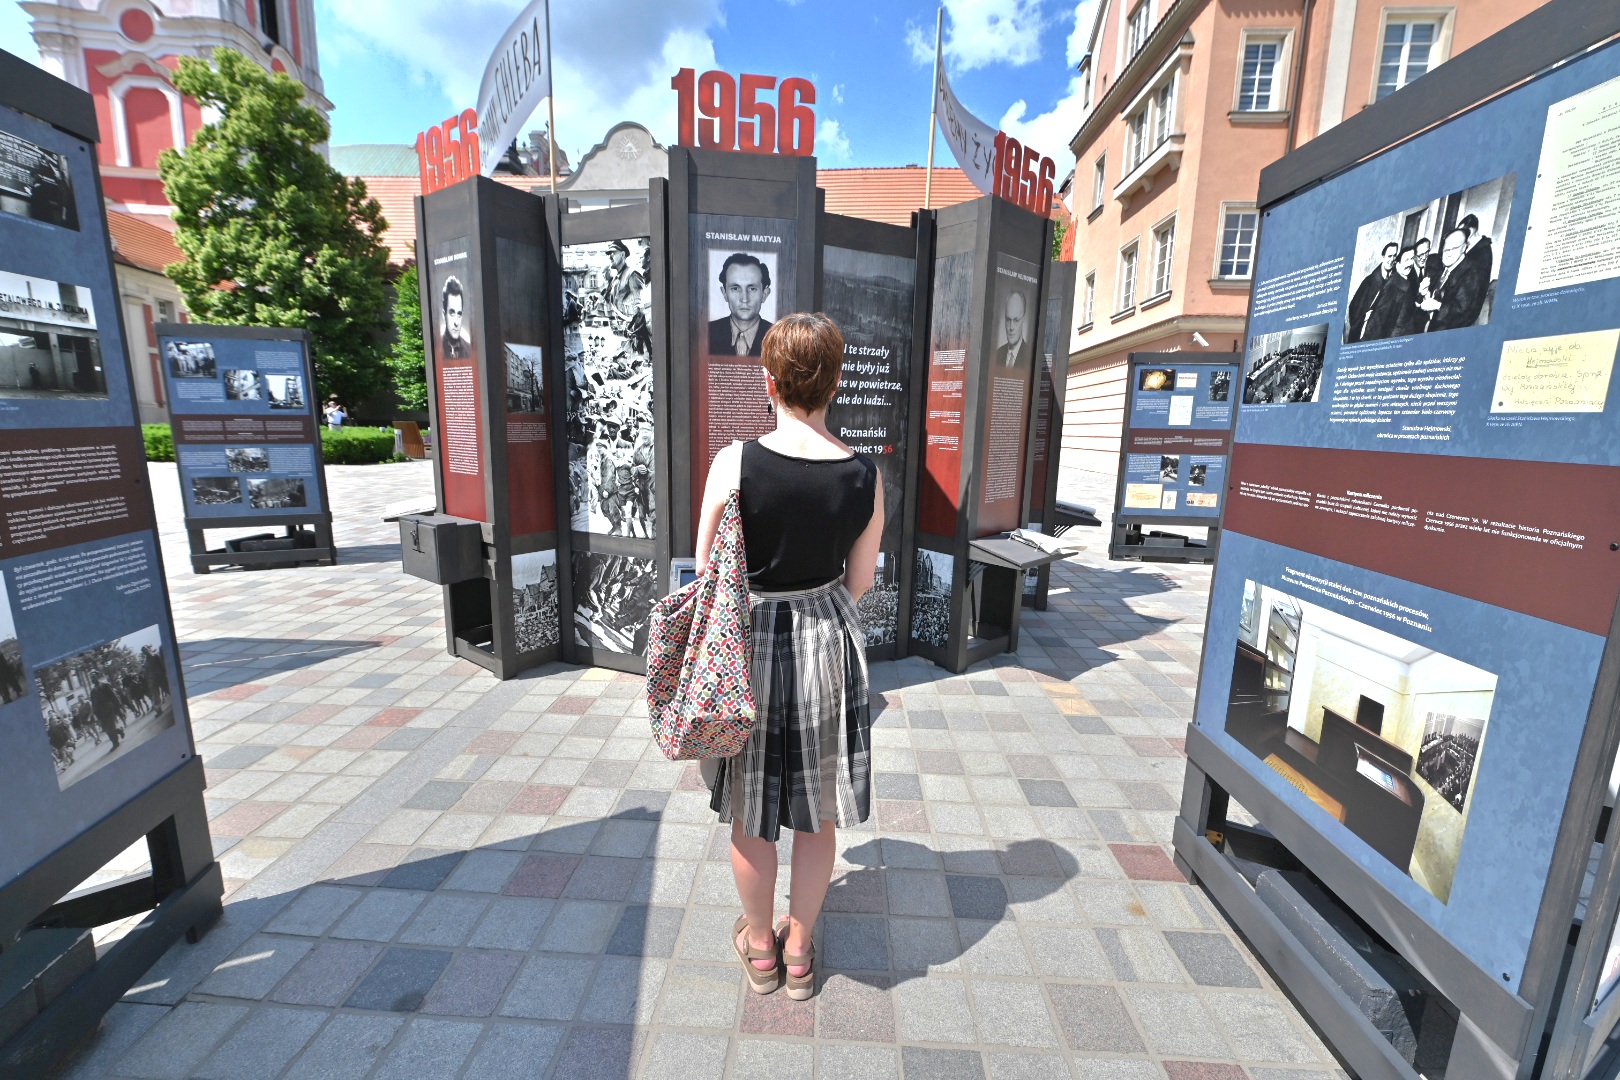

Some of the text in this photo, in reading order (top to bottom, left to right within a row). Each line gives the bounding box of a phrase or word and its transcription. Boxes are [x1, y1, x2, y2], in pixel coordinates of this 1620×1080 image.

[495, 16, 541, 124] CHLEBA
[671, 67, 816, 157] 1956
[415, 108, 481, 194] 1956
[993, 129, 1055, 218] 1956
[706, 232, 781, 244] STANISŁAW MATYJA
[844, 344, 889, 359] I te strzały
[842, 360, 890, 375] nie były już
[859, 379, 902, 391] powietrze,
[837, 394, 891, 405] ale do ludzi...
[841, 427, 886, 437] Poznański
[874, 444, 893, 454] 1956
[1490, 521, 1516, 530] rezultacie
[1519, 524, 1540, 534] historia
[1542, 528, 1585, 541] Poznańskiego
[1501, 530, 1541, 542] funkcjonowała
[1550, 538, 1583, 550] oficjalnym
[1286, 567, 1305, 577] Fragment
[1364, 592, 1398, 609] poznańskich
[1399, 604, 1429, 620] procesów,
[1359, 601, 1383, 615] Czerwiec
[1383, 611, 1396, 620] 1956
[1403, 617, 1432, 633] Poznaniu
